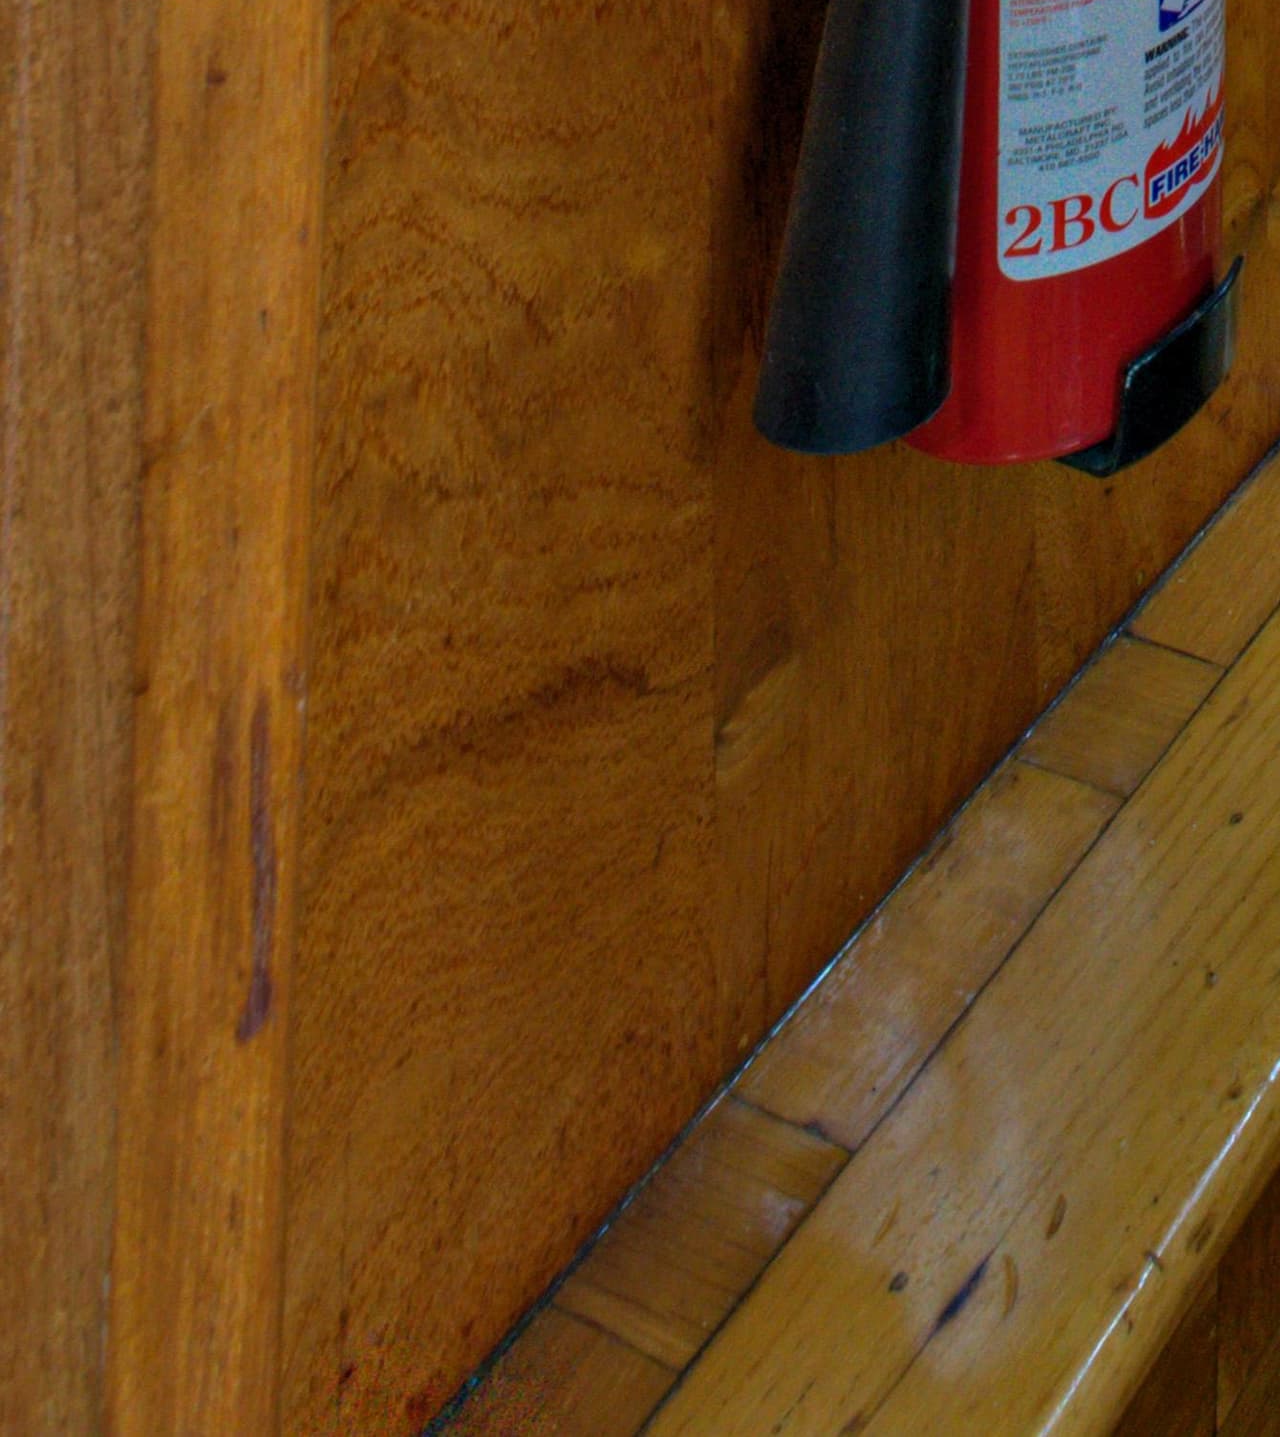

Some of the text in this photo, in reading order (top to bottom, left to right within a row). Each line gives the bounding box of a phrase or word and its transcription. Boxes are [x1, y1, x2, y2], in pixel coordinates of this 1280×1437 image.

[1018, 111, 1101, 136] MANUFACTURED
[1025, 124, 1091, 145] METALCRAFT
[1003, 174, 1140, 259] 2BC
